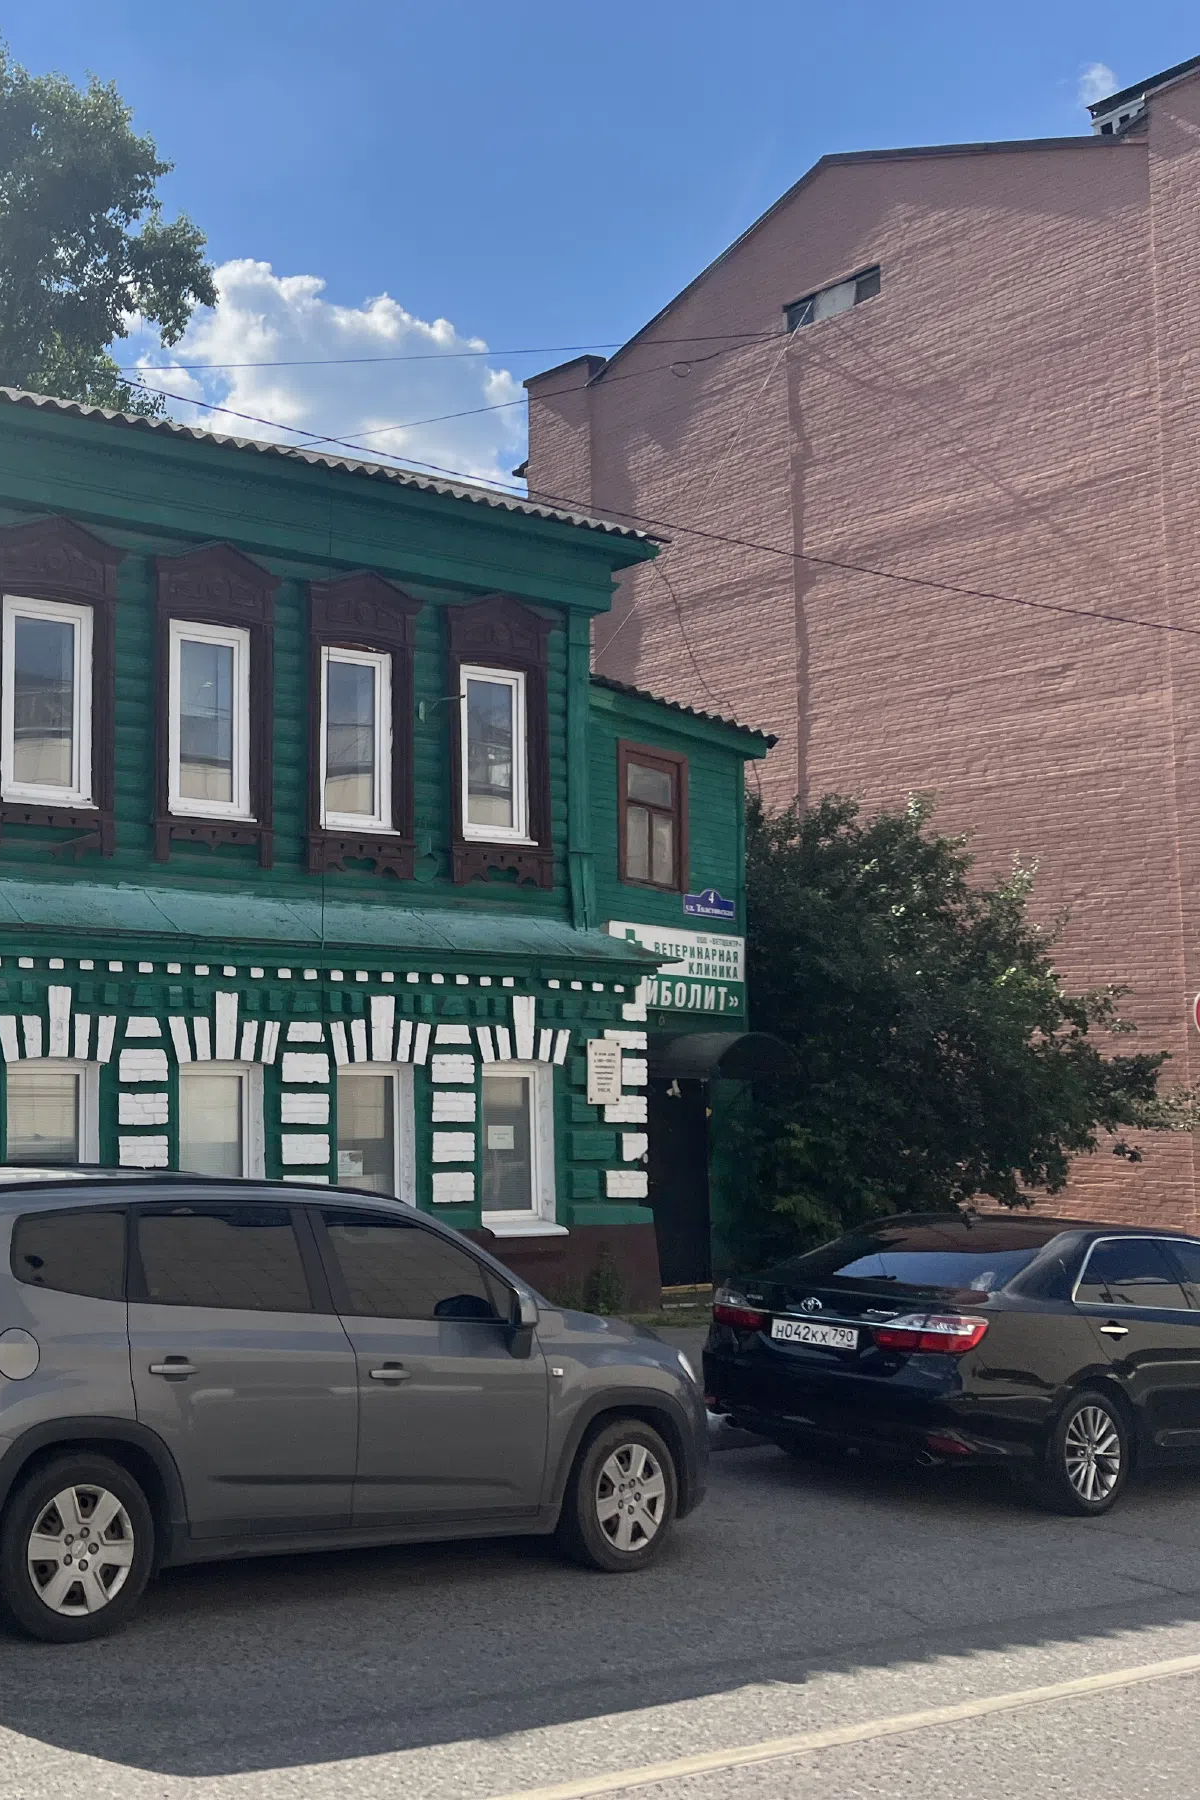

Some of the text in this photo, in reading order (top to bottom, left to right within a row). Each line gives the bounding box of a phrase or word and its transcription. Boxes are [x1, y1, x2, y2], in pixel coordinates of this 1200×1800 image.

[708, 891, 715, 904] 4
[654, 941, 739, 963] ВЕТЕРИНАРНАЯ
[688, 962, 738, 979] КЛИНИКА
[831, 1328, 854, 1343] 790
